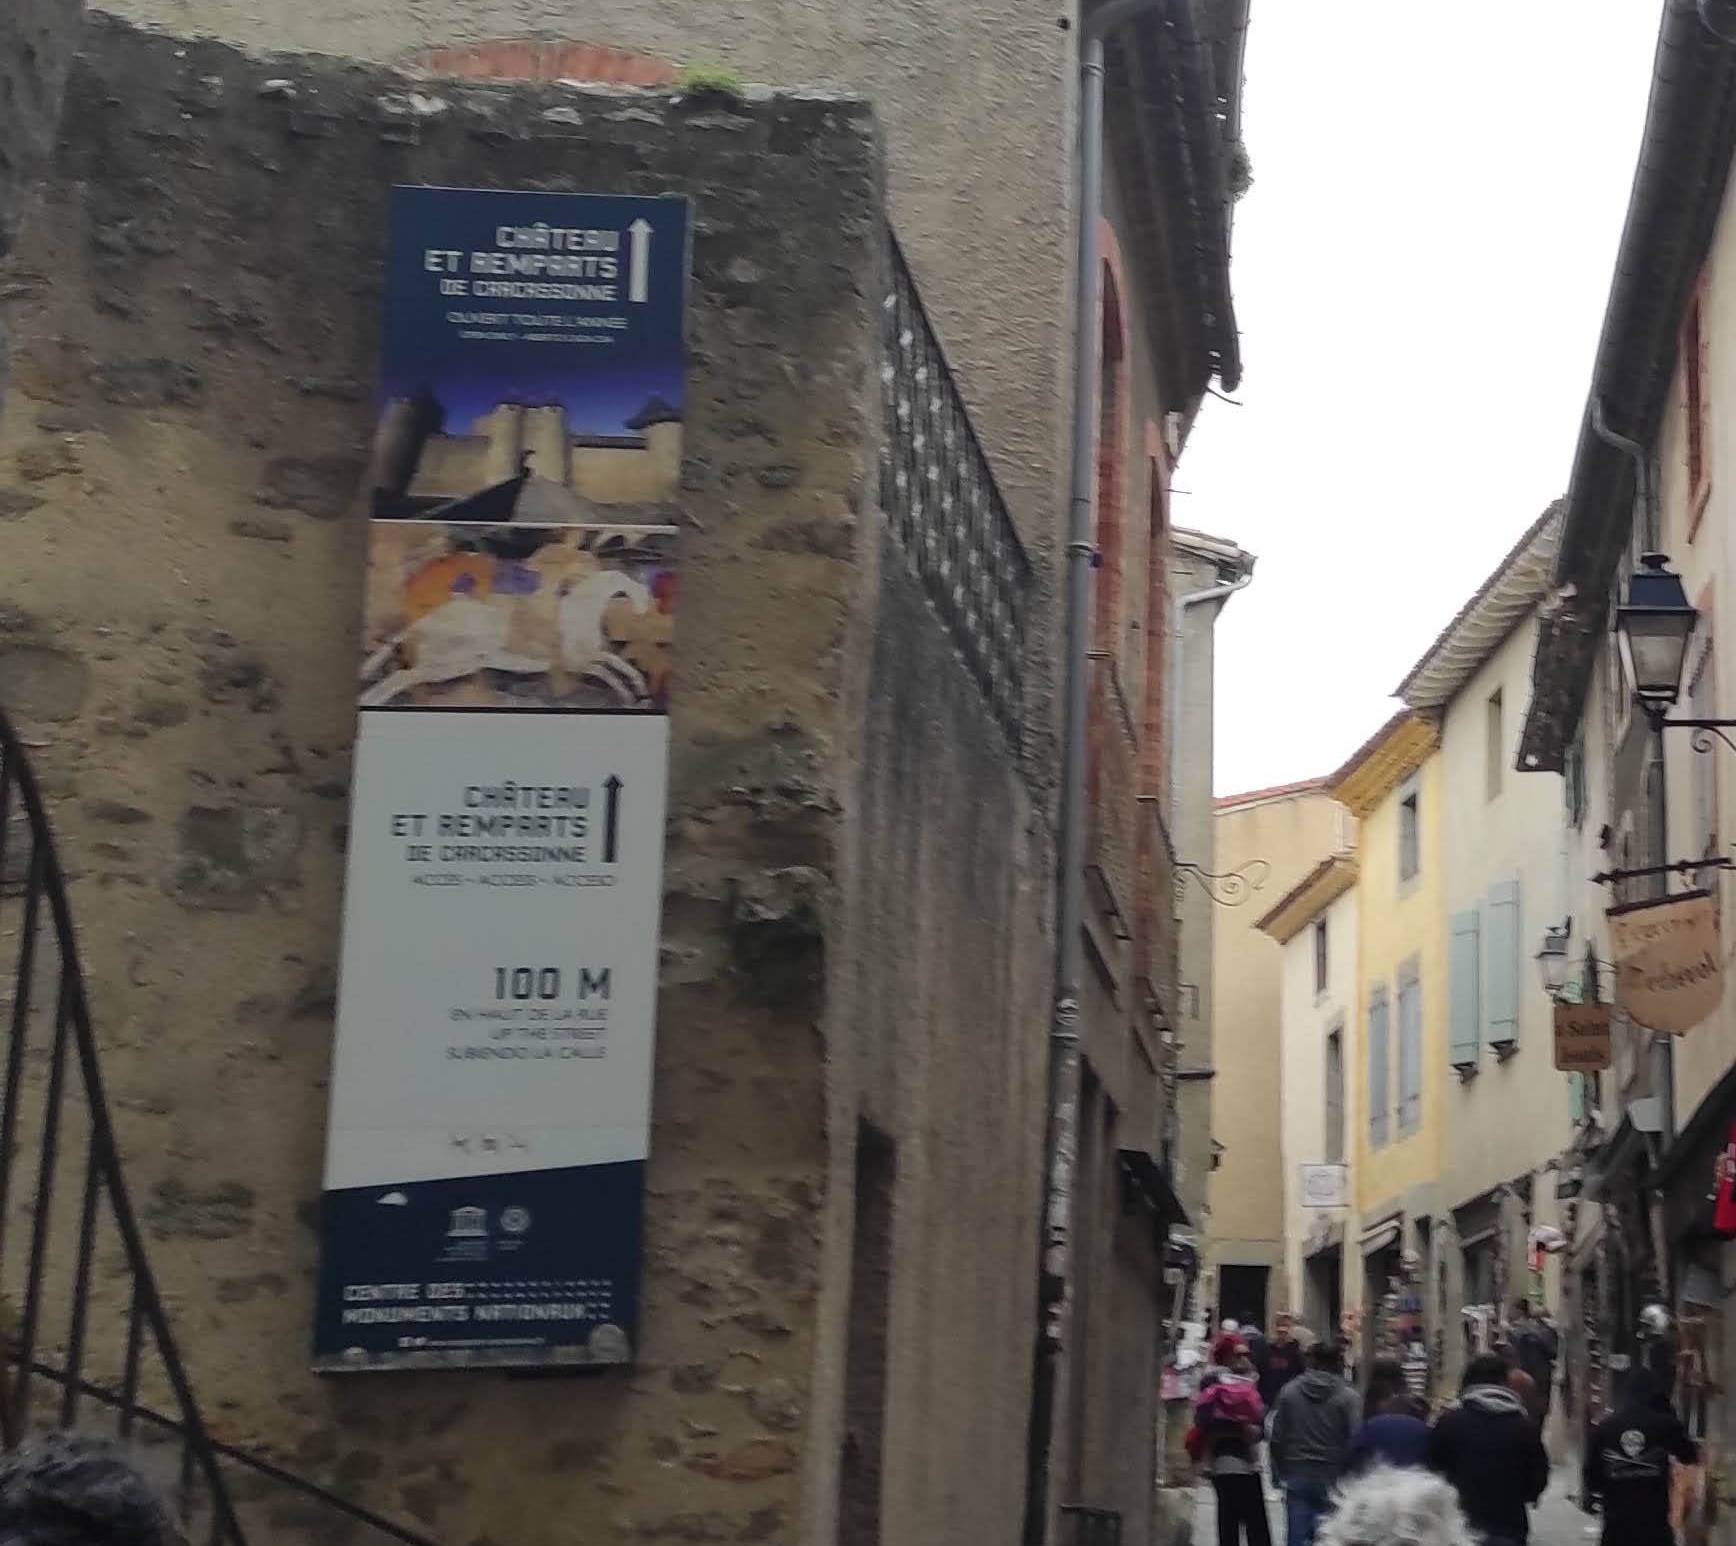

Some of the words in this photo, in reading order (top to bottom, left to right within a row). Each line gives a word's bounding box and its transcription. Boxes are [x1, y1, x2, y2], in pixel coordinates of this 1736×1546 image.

[496, 221, 620, 251] CHÂTEAU
[424, 250, 463, 272] ET
[470, 251, 618, 278] REMPARTS
[440, 278, 469, 295] DE
[472, 280, 618, 301] CARCASSONNE
[463, 781, 590, 808] CHÂTEAU
[390, 815, 428, 837] ET
[437, 815, 587, 838] REMPARTS
[405, 845, 432, 862] DE
[440, 845, 587, 862] CARCASSONNE
[494, 967, 560, 1000] 100
[577, 967, 611, 1000] M
